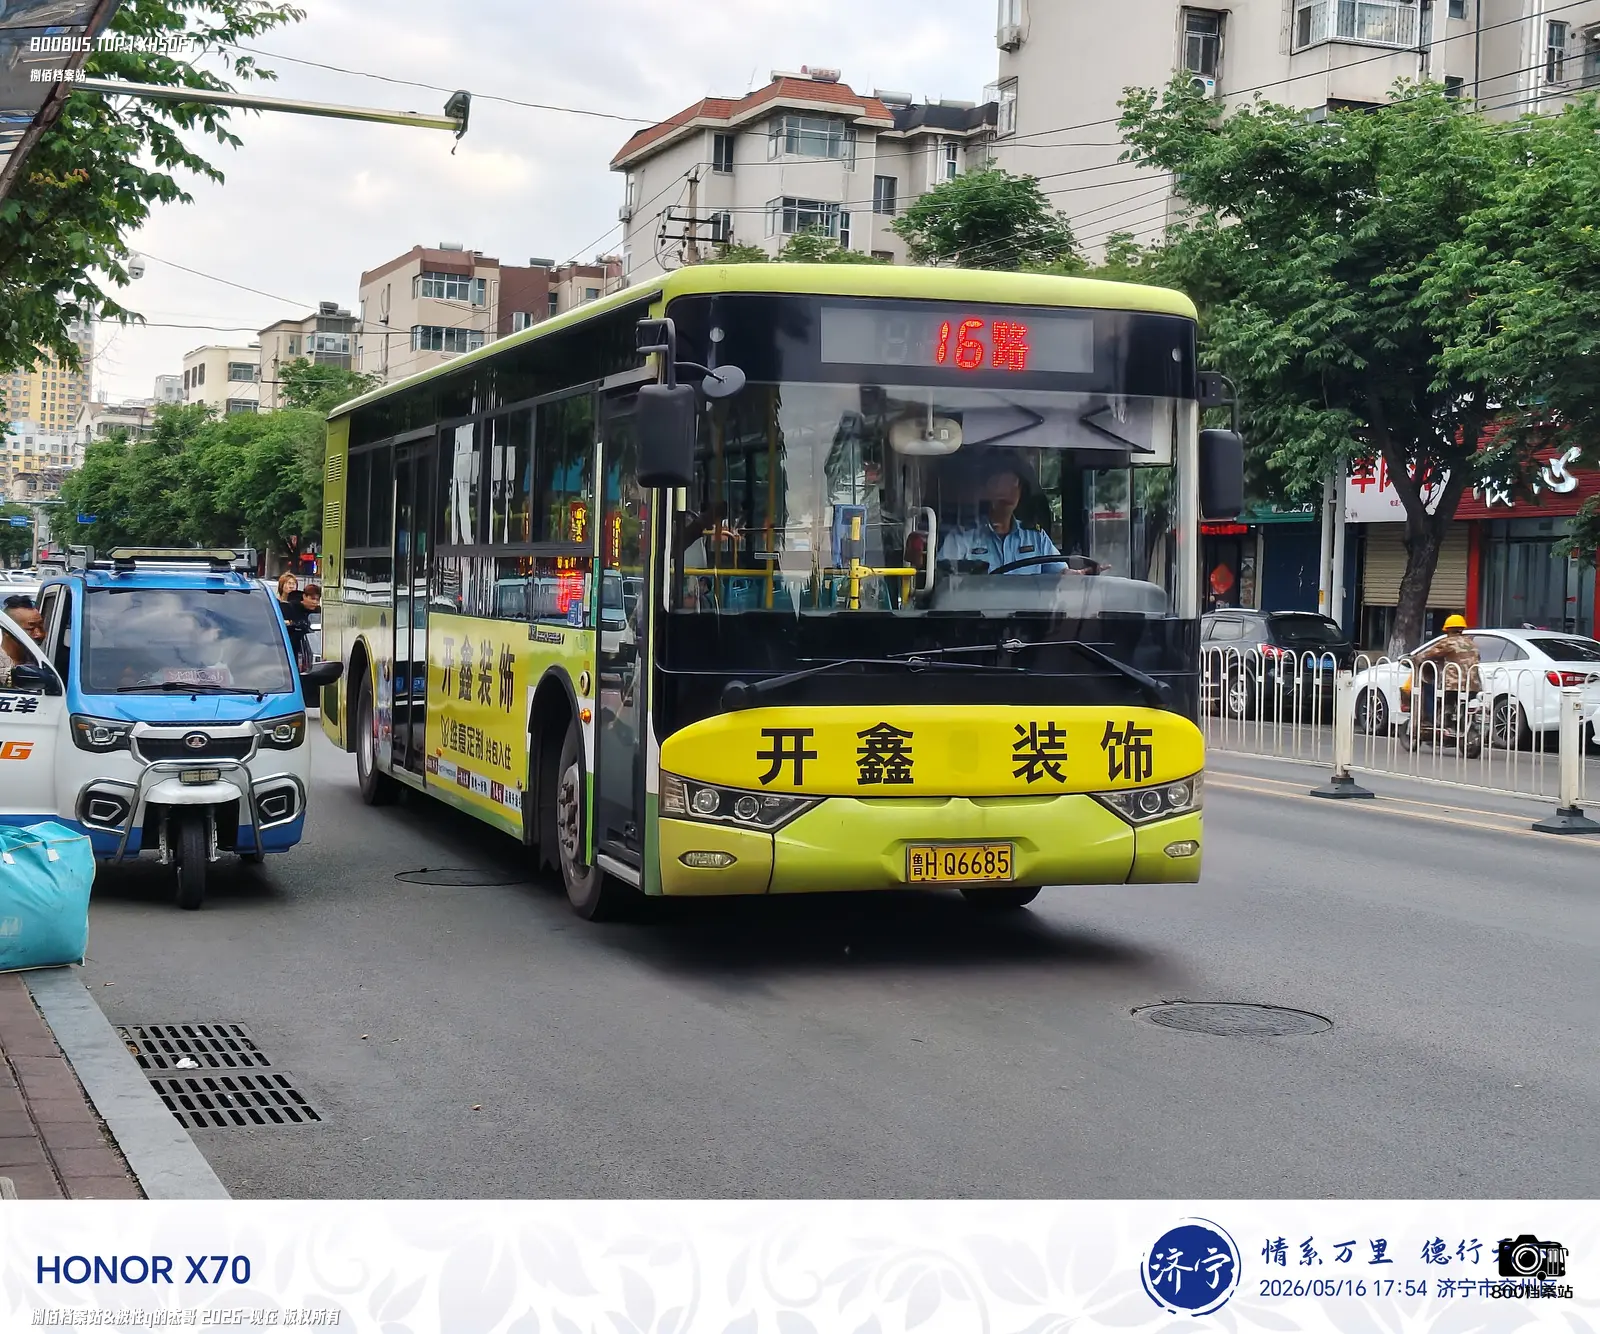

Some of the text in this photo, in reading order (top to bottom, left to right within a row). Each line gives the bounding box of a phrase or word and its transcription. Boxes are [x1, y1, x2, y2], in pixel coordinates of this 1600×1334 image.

[936, 319, 1029, 371] 16路
[441, 635, 516, 713] 开鑫装饰
